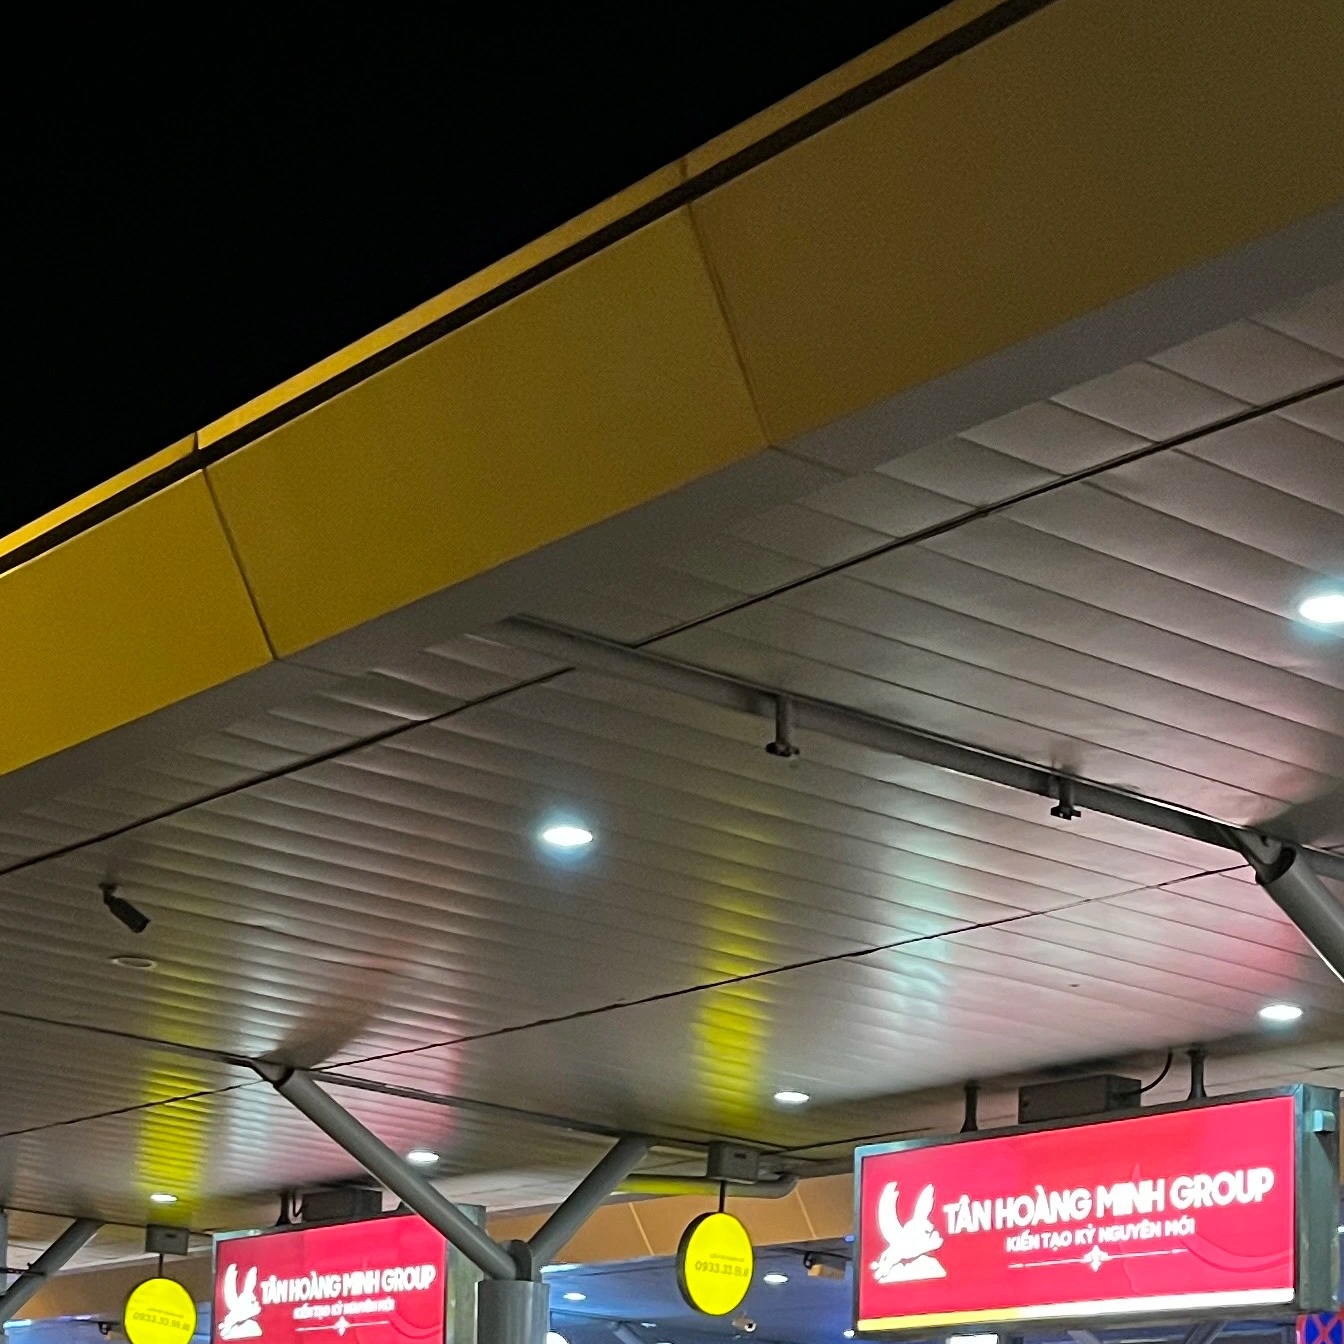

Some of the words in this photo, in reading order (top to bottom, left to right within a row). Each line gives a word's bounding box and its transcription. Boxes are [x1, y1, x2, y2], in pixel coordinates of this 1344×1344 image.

[943, 1193, 992, 1235] TÂN
[996, 1184, 1091, 1230] HOÀNG
[1095, 1176, 1165, 1217] MINH
[1169, 1166, 1275, 1209] GROUP
[1006, 1231, 1038, 1254] KIẾN
[1041, 1229, 1073, 1251] TẠO
[1099, 1221, 1164, 1243] NGUYÊN
[260, 1275, 288, 1305] TÂN
[289, 1272, 341, 1303] HOÀNG
[342, 1268, 380, 1296] MINH
[381, 1263, 437, 1292] GROUP
